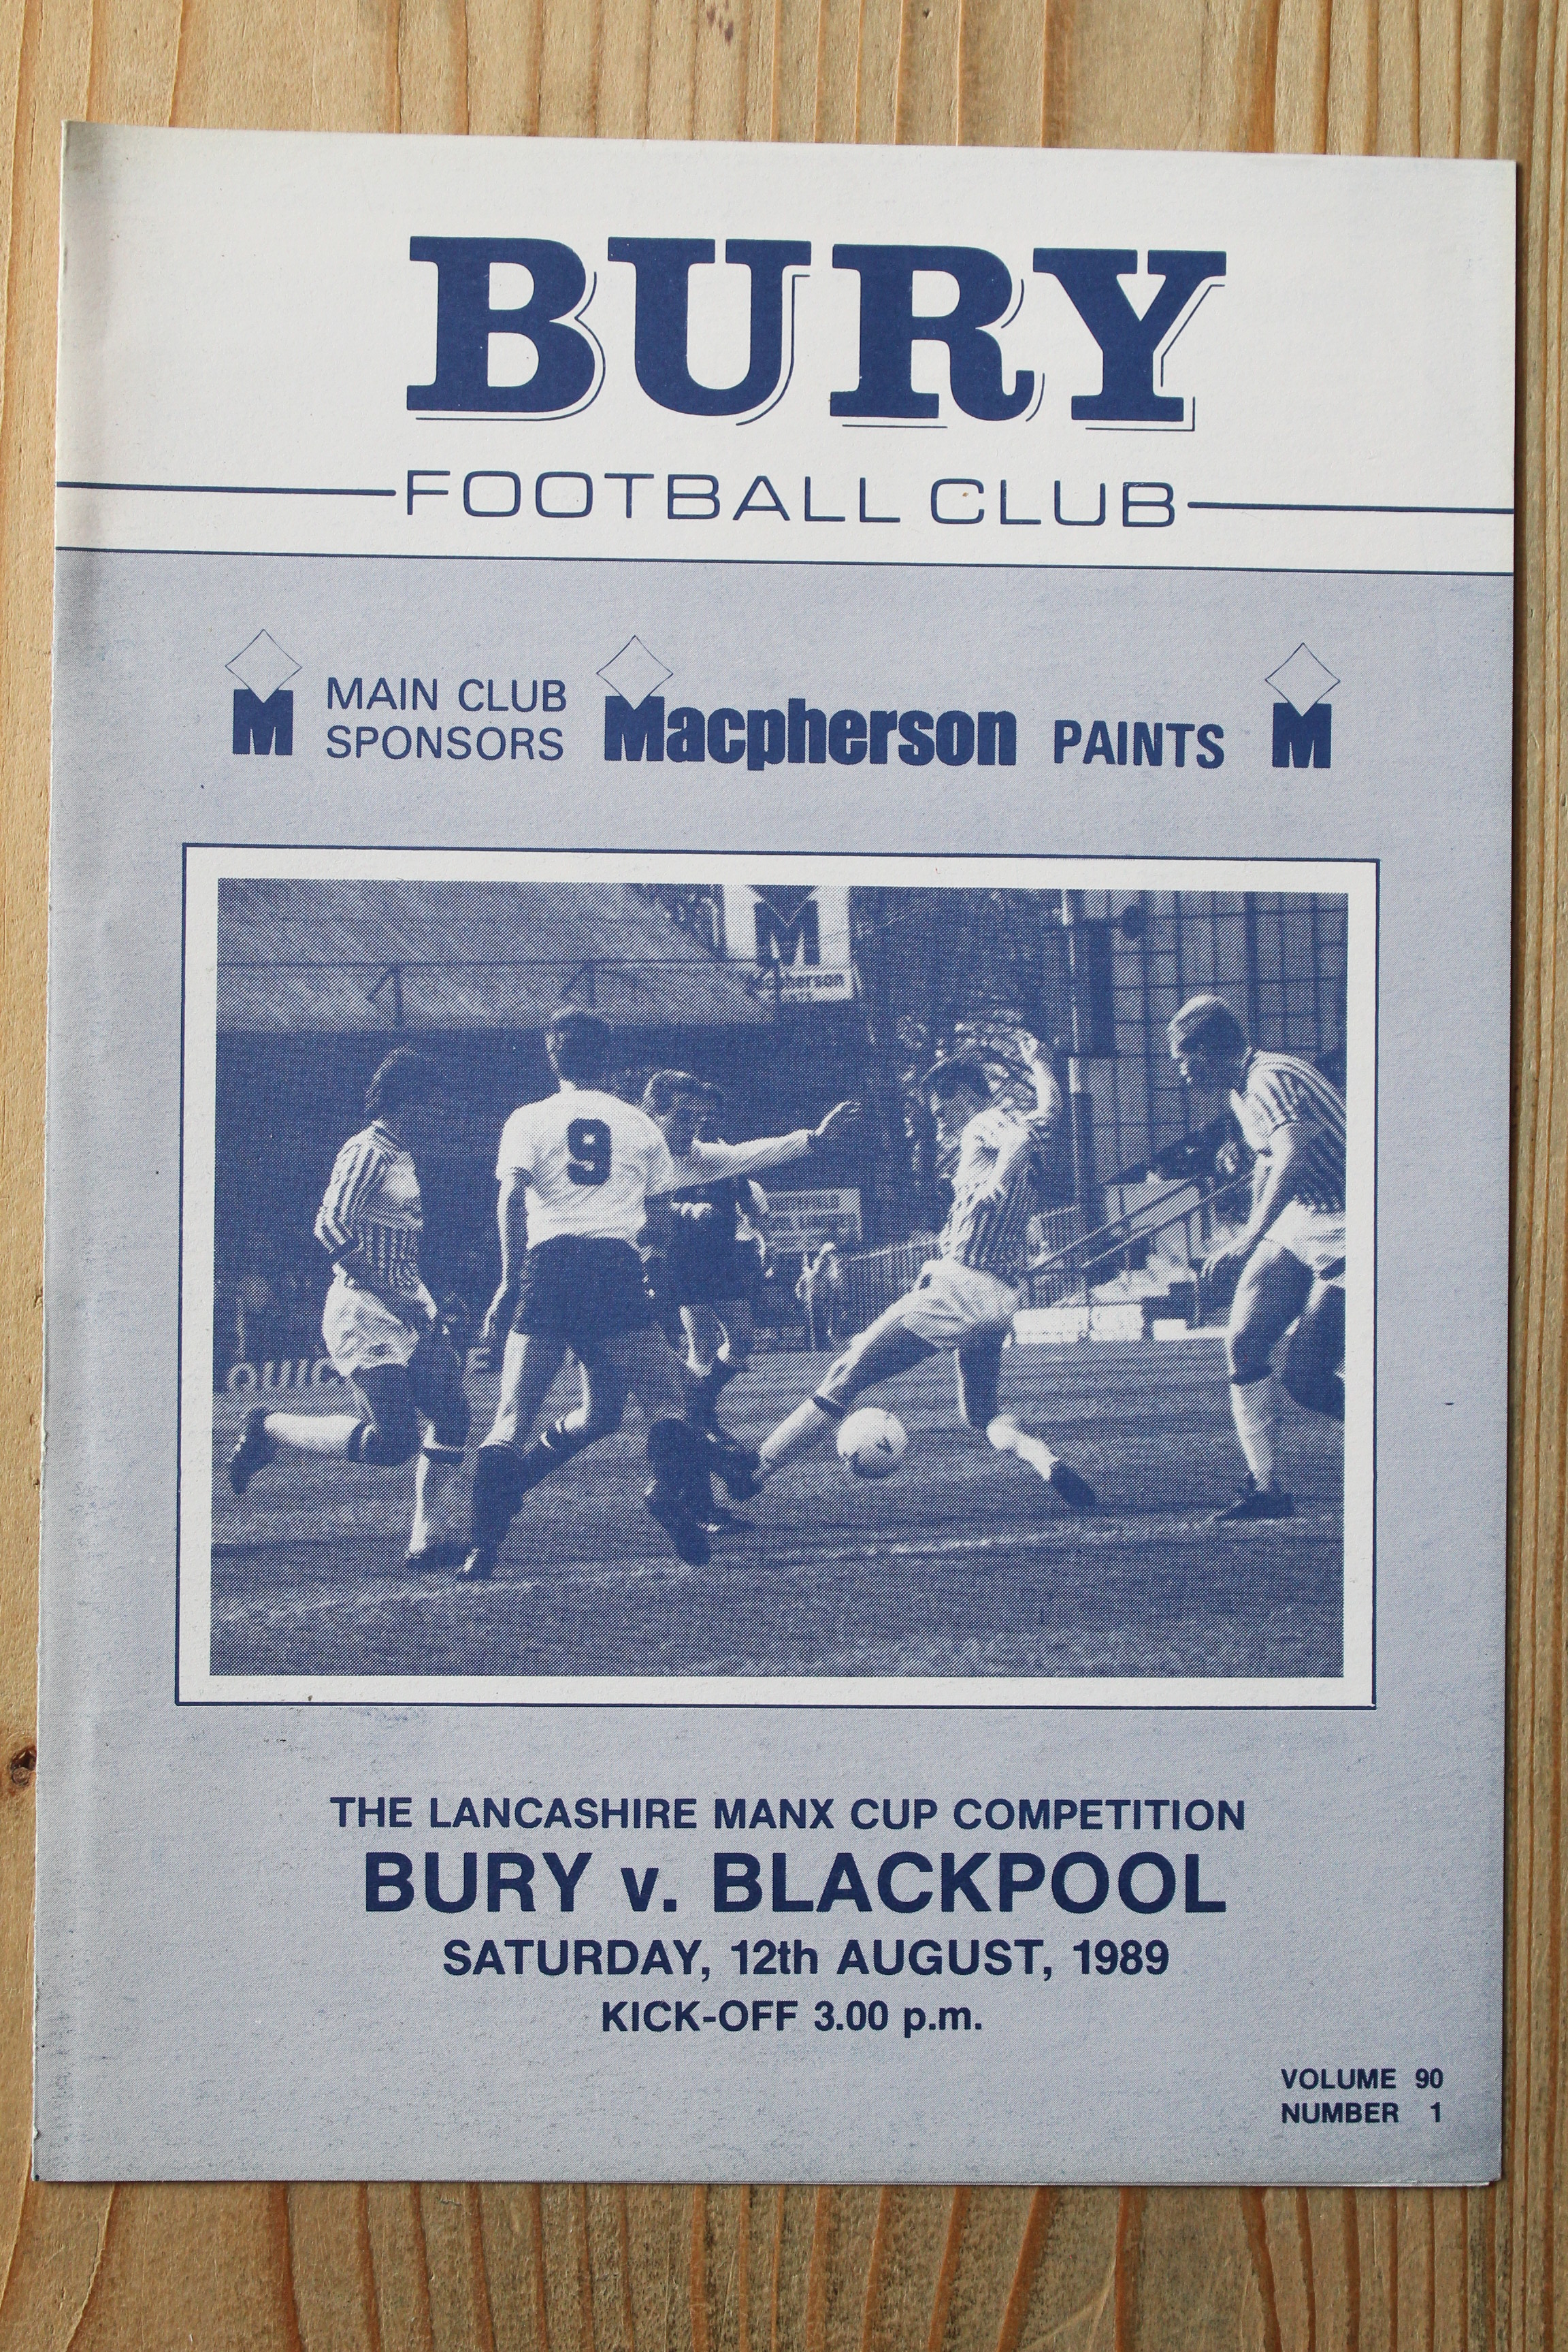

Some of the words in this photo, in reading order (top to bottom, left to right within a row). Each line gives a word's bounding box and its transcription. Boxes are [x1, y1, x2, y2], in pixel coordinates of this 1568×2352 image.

[406, 235, 1226, 430] BURY
[407, 470, 900, 523] FOOTBALL
[930, 478, 1175, 527] CLUB
[327, 676, 438, 711] MAIN
[457, 678, 567, 713] CLUB
[233, 688, 293, 755] M
[604, 694, 1017, 771] Macpherson
[1054, 719, 1225, 769] PAINTS
[1272, 702, 1332, 768] M
[326, 724, 564, 762] SPONSORS
[567, 1118, 612, 1186] 9
[227, 1357, 339, 1393] QUIC
[330, 1797, 412, 1828] THE
[430, 1797, 697, 1829] LANCASHIRE
[715, 1798, 834, 1829] MANX
[858, 1798, 938, 1831] CUP
[953, 1799, 1245, 1831] COMPETITION
[365, 1852, 592, 1914] BURY
[621, 1867, 677, 1912] v.
[713, 1851, 1226, 1914] BLACKPOOL
[444, 1939, 710, 1981] SATURDAY,
[731, 1939, 818, 1975] 12th
[836, 1939, 1052, 1980] AUGUST,
[1073, 1940, 1169, 1976] 1989
[602, 1999, 798, 2033] KICK-OFF
[814, 1999, 889, 2032] 3.00
[904, 2007, 982, 2039] p.m.
[1281, 2068, 1396, 2090] VOLUME
[1415, 2068, 1444, 2089] 90
[1281, 2102, 1399, 2124] NUMBER
[1431, 2102, 1441, 2123] 1
